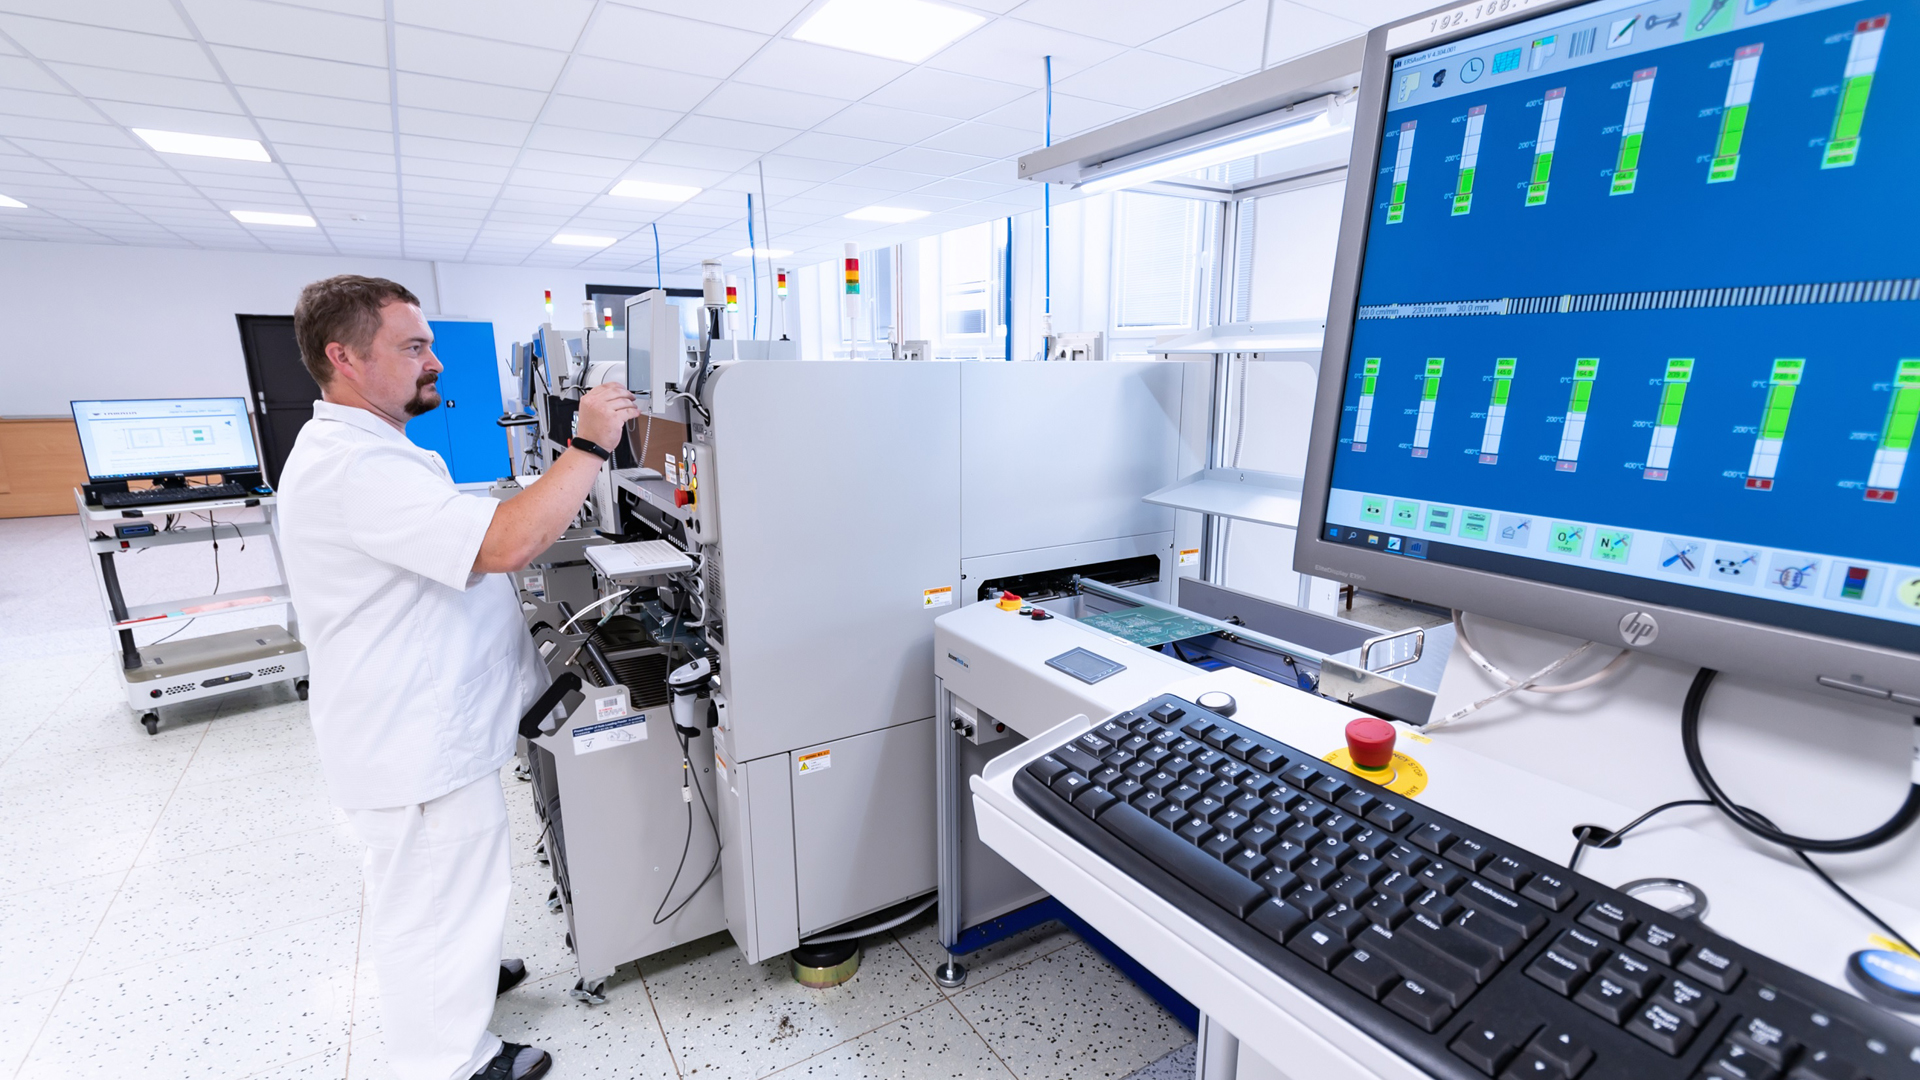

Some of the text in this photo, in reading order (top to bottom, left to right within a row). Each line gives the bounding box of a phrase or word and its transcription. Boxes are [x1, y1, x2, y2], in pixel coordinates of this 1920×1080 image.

[1430, 0, 1530, 33] 192.168.
[1600, 169, 1612, 177] 0°C
[1315, 564, 1348, 578] EliteDisplay
[1624, 611, 1654, 645] hp
[1464, 840, 1481, 850] F10
[1502, 857, 1519, 868] F11
[1542, 875, 1561, 887] F12
[1472, 880, 1518, 907] Backspace
[1272, 899, 1284, 907] Alt
[1416, 914, 1440, 930] Enter
[1372, 924, 1393, 939] Shift
[1570, 929, 1598, 947] Insert
[1547, 951, 1577, 970] Delete
[1619, 953, 1648, 971] Home
[1406, 981, 1425, 995] Ctrl
[1601, 979, 1623, 994] End
[1673, 980, 1701, 998] Page
[1646, 1010, 1677, 1031] Down
[1652, 1005, 1680, 1024] Page
